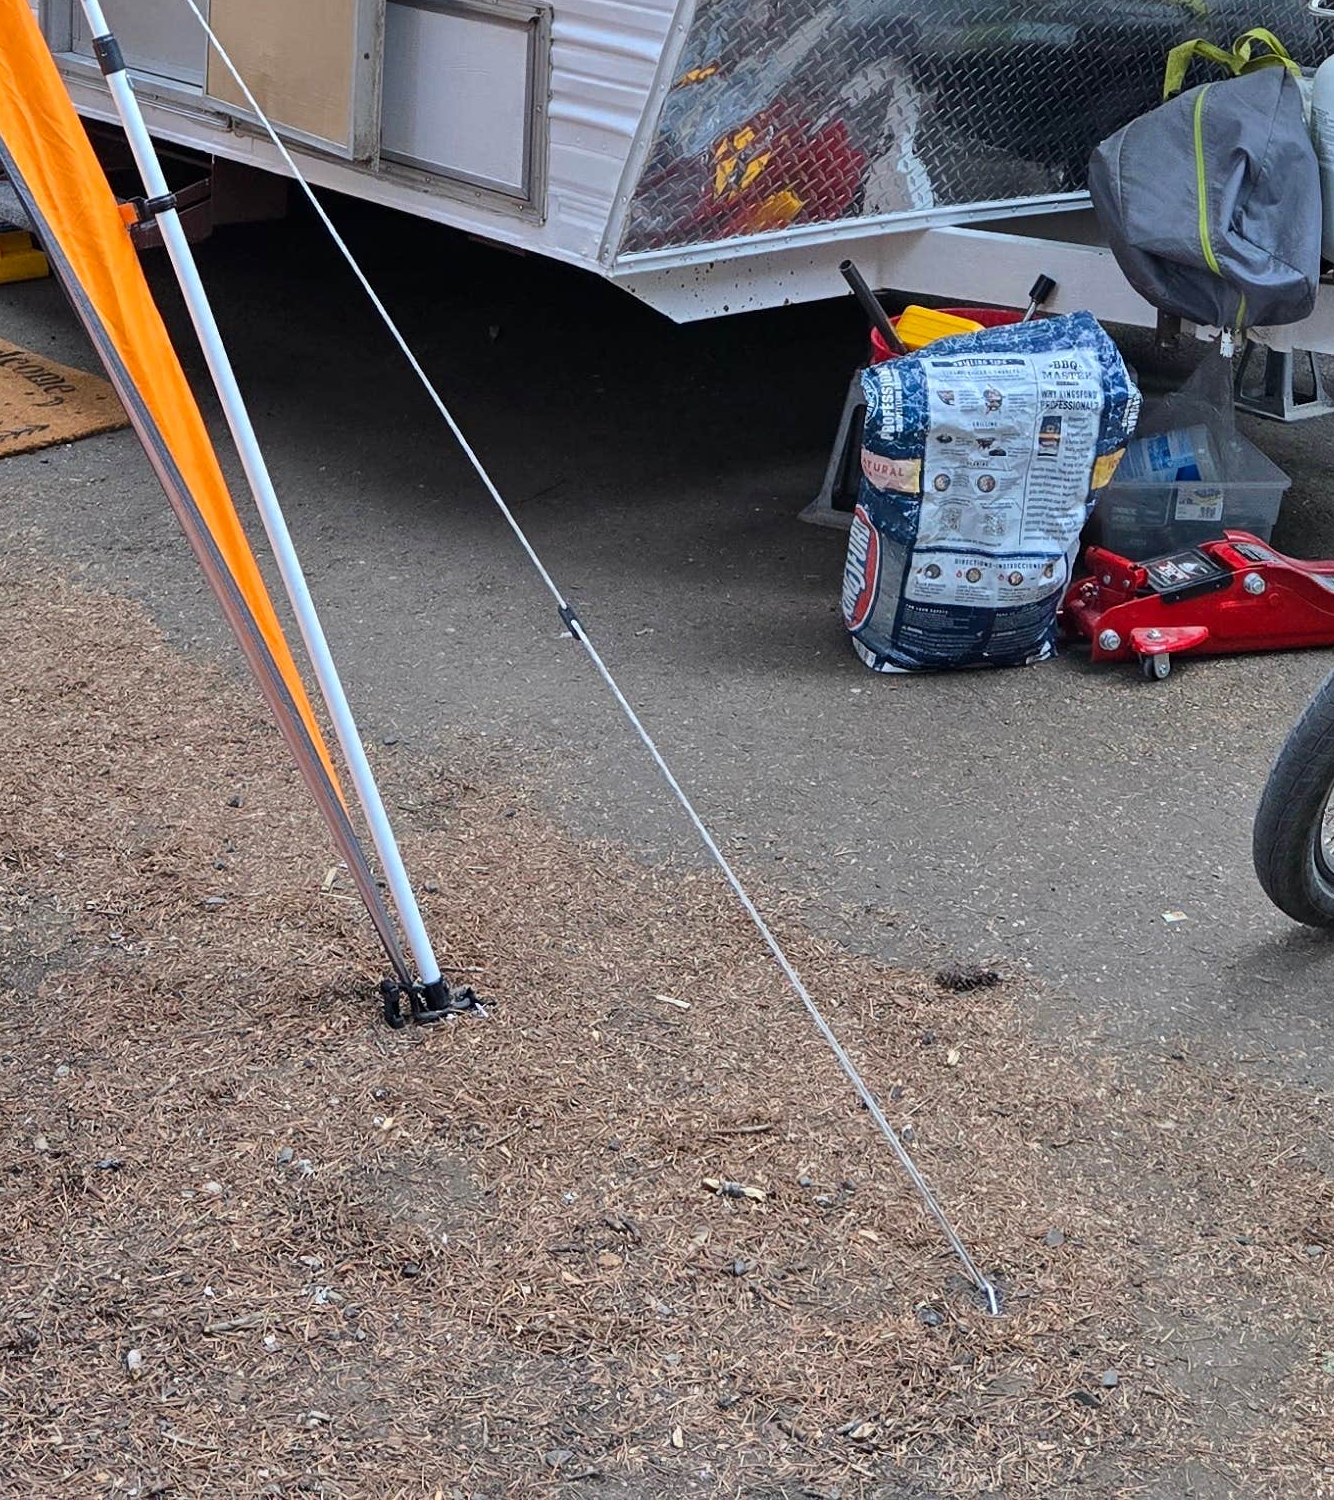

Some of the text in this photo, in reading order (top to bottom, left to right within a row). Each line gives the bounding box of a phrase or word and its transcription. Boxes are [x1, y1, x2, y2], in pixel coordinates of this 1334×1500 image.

[1052, 360, 1078, 371] BBQ
[1042, 371, 1092, 380] MASTER
[862, 459, 904, 477] ATURAL
